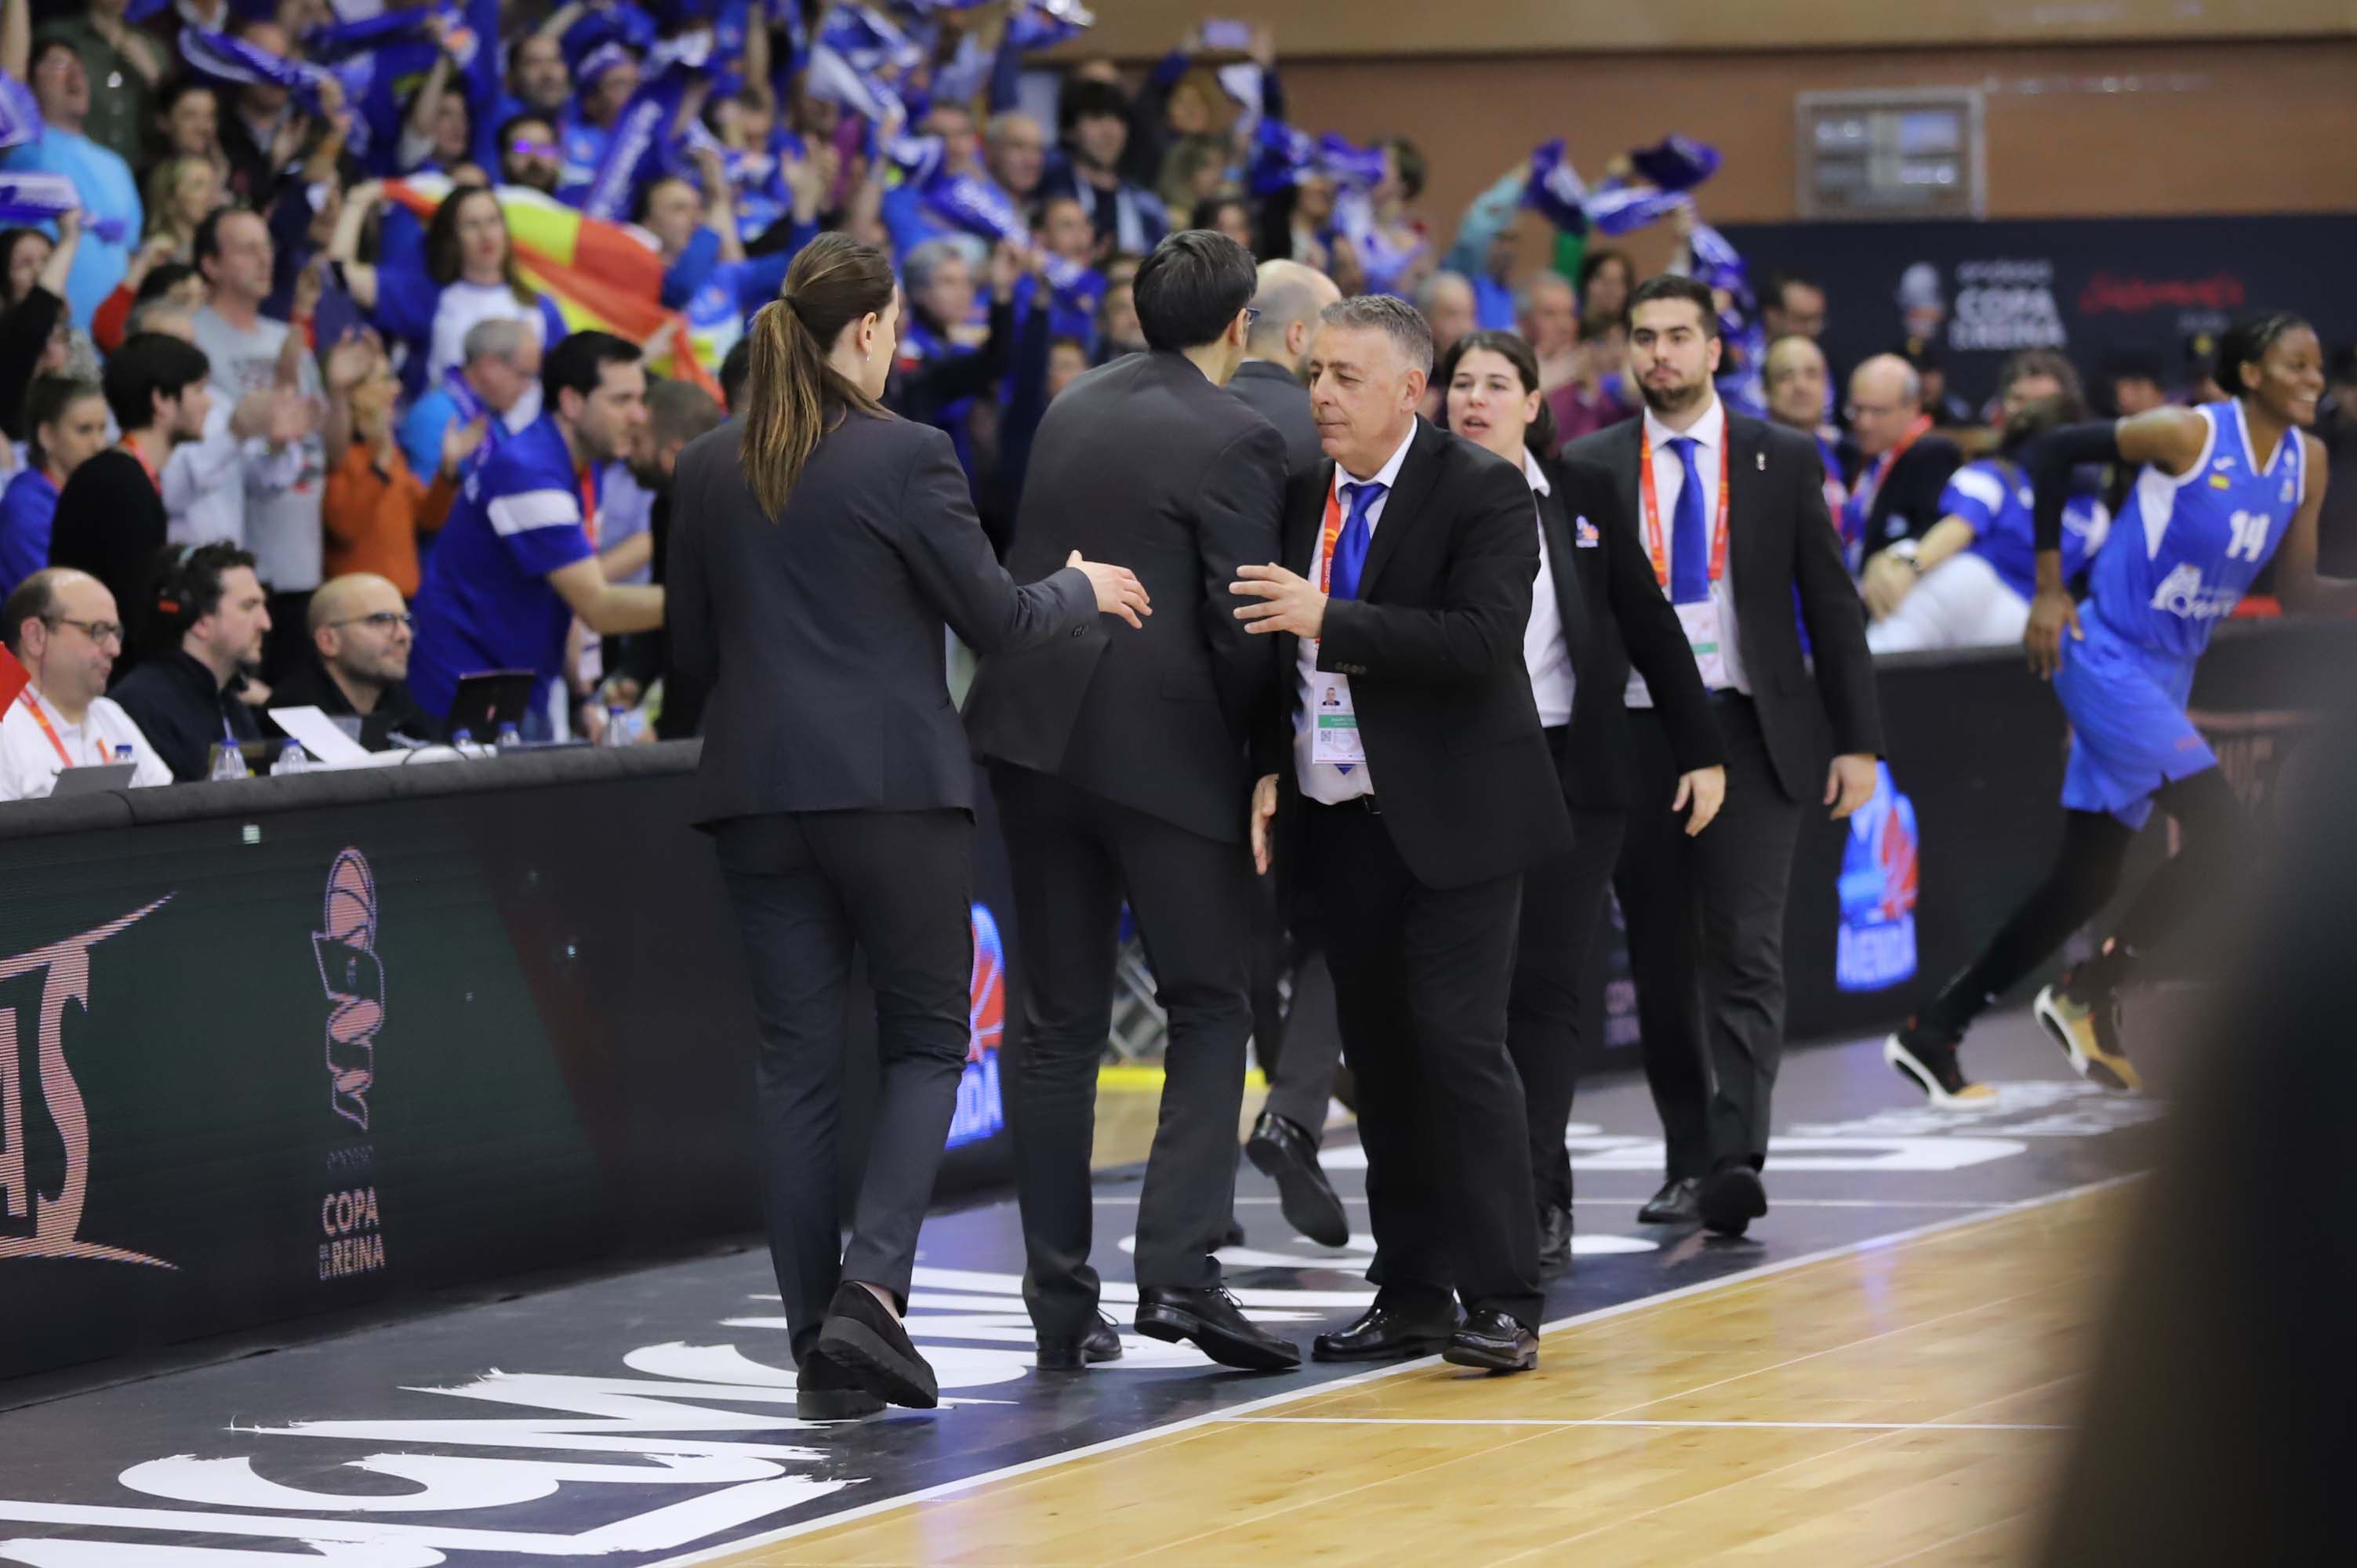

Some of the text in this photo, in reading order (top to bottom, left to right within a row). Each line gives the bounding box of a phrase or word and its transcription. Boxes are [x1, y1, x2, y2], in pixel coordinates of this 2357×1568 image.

[2226, 510, 2270, 562] 14
[322, 1186, 380, 1236] COPA
[332, 1234, 386, 1277] REINA
